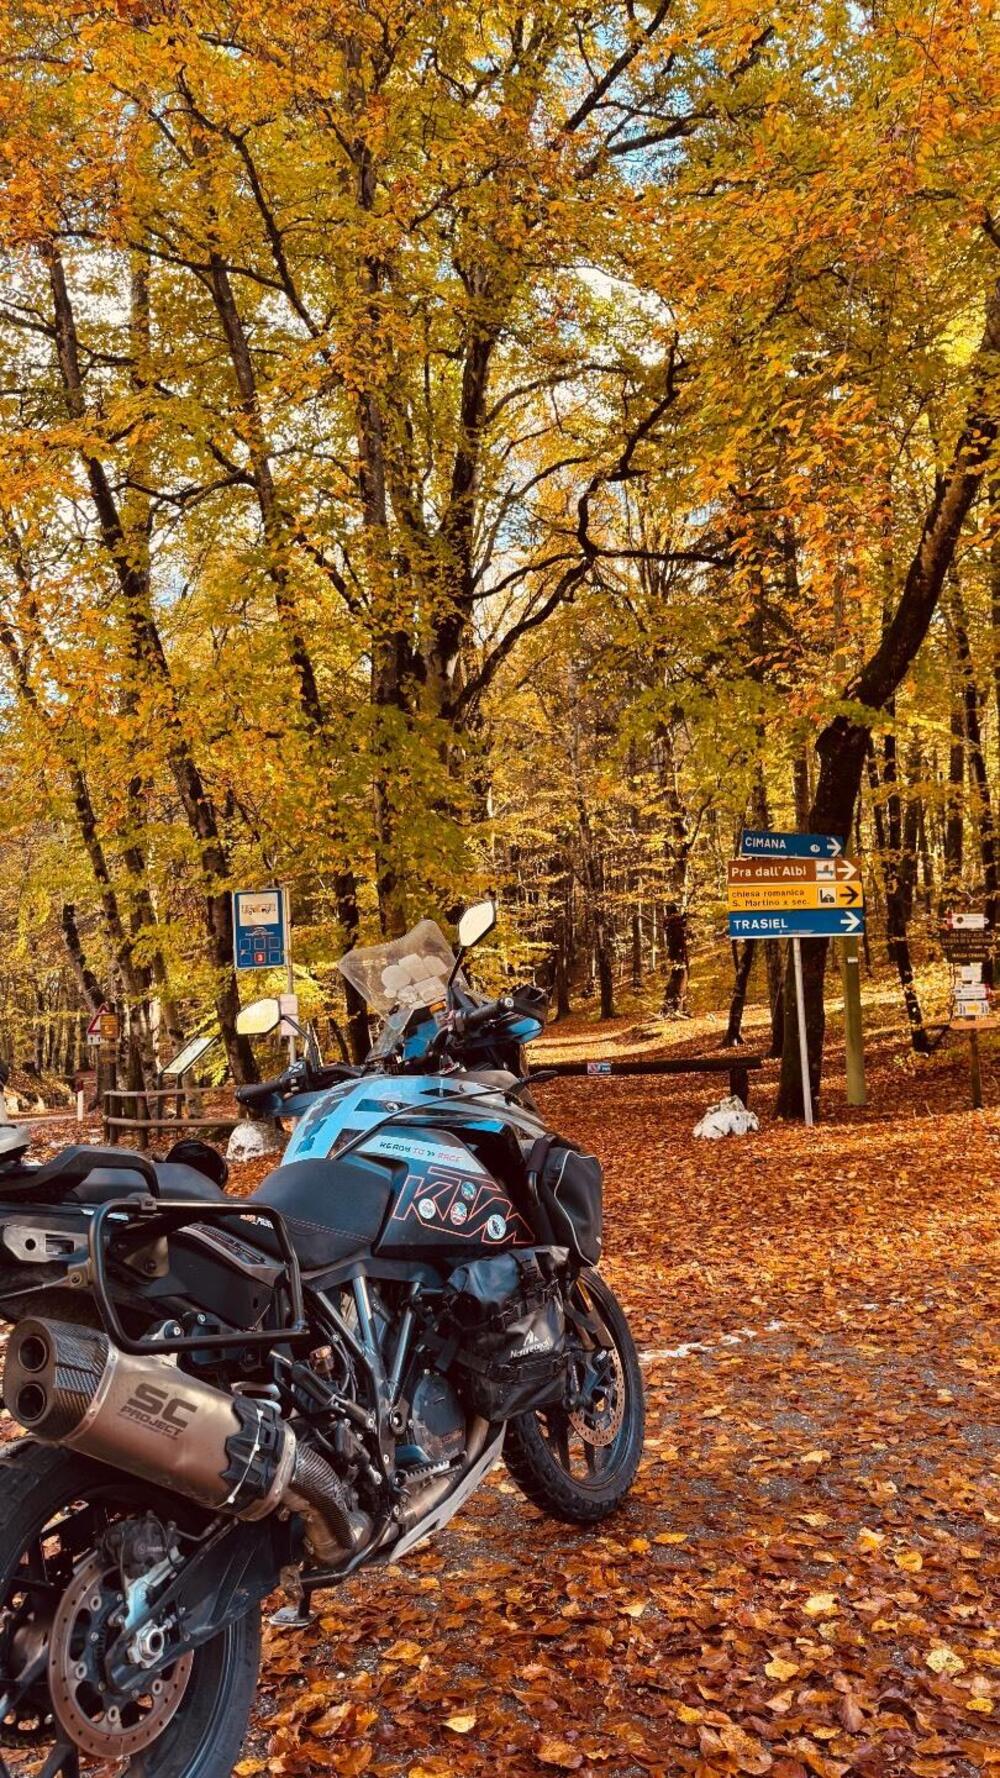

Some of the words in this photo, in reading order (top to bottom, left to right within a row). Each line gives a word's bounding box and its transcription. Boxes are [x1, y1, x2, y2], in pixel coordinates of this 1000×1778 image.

[745, 836, 787, 849] CIMANA
[731, 867, 752, 877] Pra
[755, 865, 807, 877] dall'Albi
[731, 889, 760, 898] chiesa
[763, 888, 805, 897] romanica
[732, 899, 741, 907] S.
[745, 899, 780, 907] Martino
[733, 918, 789, 930] TRASIEL
[391, 1166, 535, 1243] KTM
[127, 1383, 198, 1428] SC
[119, 1405, 184, 1436] PROJECT
